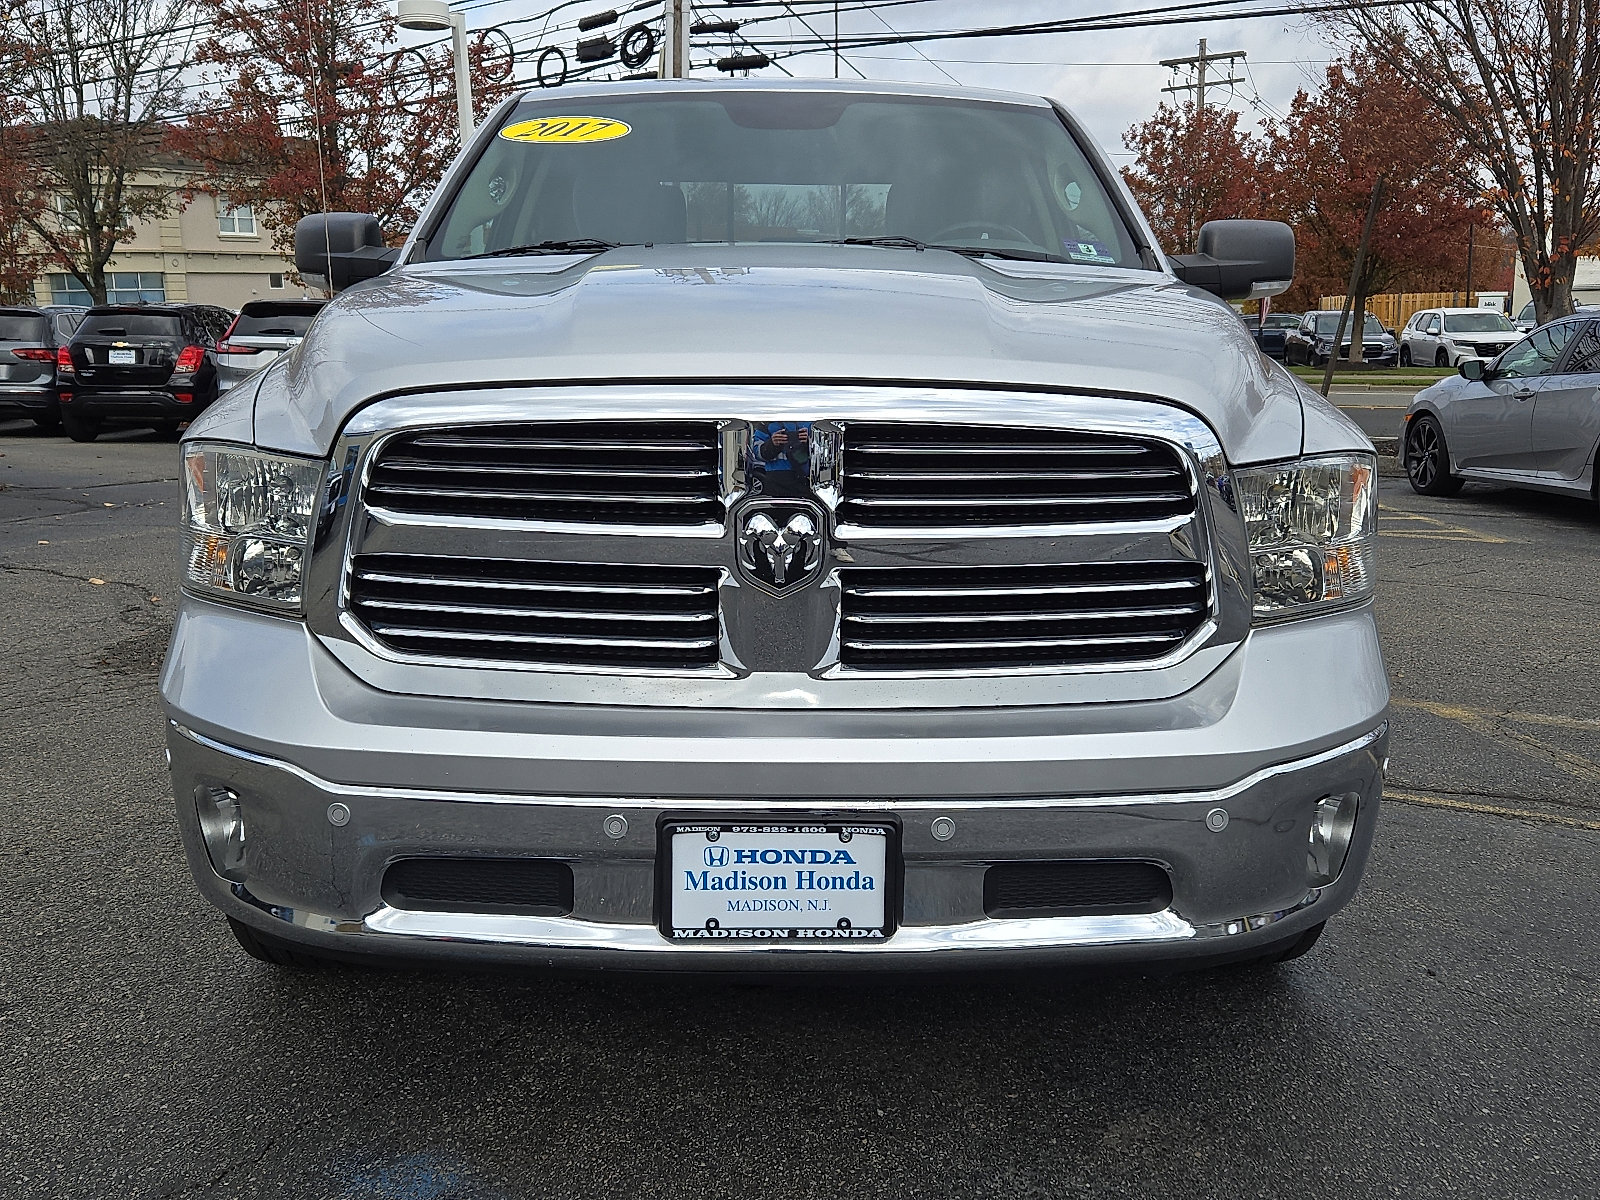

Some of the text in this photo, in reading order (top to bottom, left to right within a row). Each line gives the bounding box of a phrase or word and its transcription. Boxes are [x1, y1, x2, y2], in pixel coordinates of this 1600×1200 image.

[514, 122, 614, 137] 2017
[1084, 245, 1092, 253] 3
[841, 827, 887, 835] HONDA
[733, 849, 857, 865] HONDA
[683, 870, 875, 891] Madison Honda
[727, 899, 832, 913] MADISON, N.J.
[672, 929, 885, 938] MADISON HONDA
